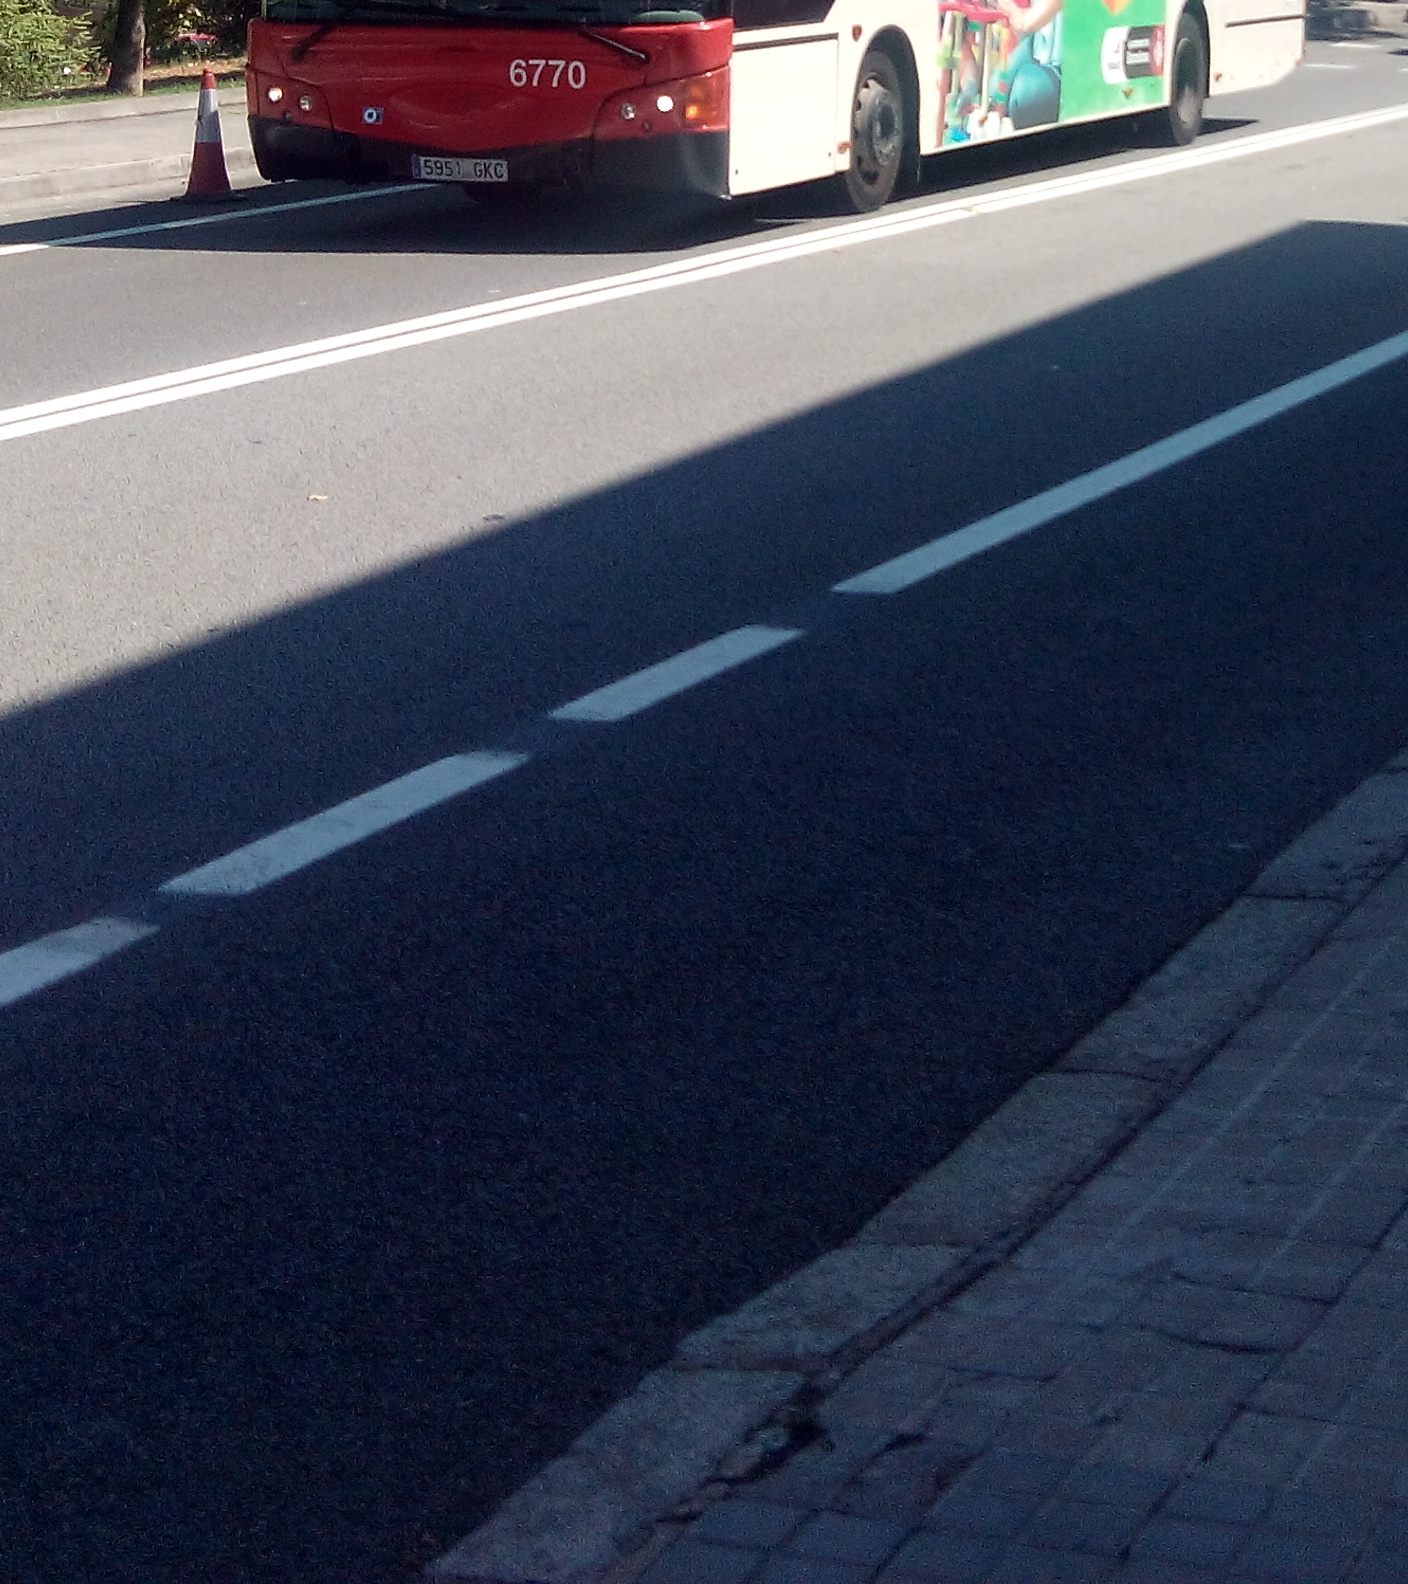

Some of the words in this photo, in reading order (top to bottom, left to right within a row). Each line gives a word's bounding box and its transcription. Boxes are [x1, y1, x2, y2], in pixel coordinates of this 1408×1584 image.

[509, 59, 586, 89] 6770
[423, 159, 463, 176] 5951
[473, 162, 504, 179] GKC
